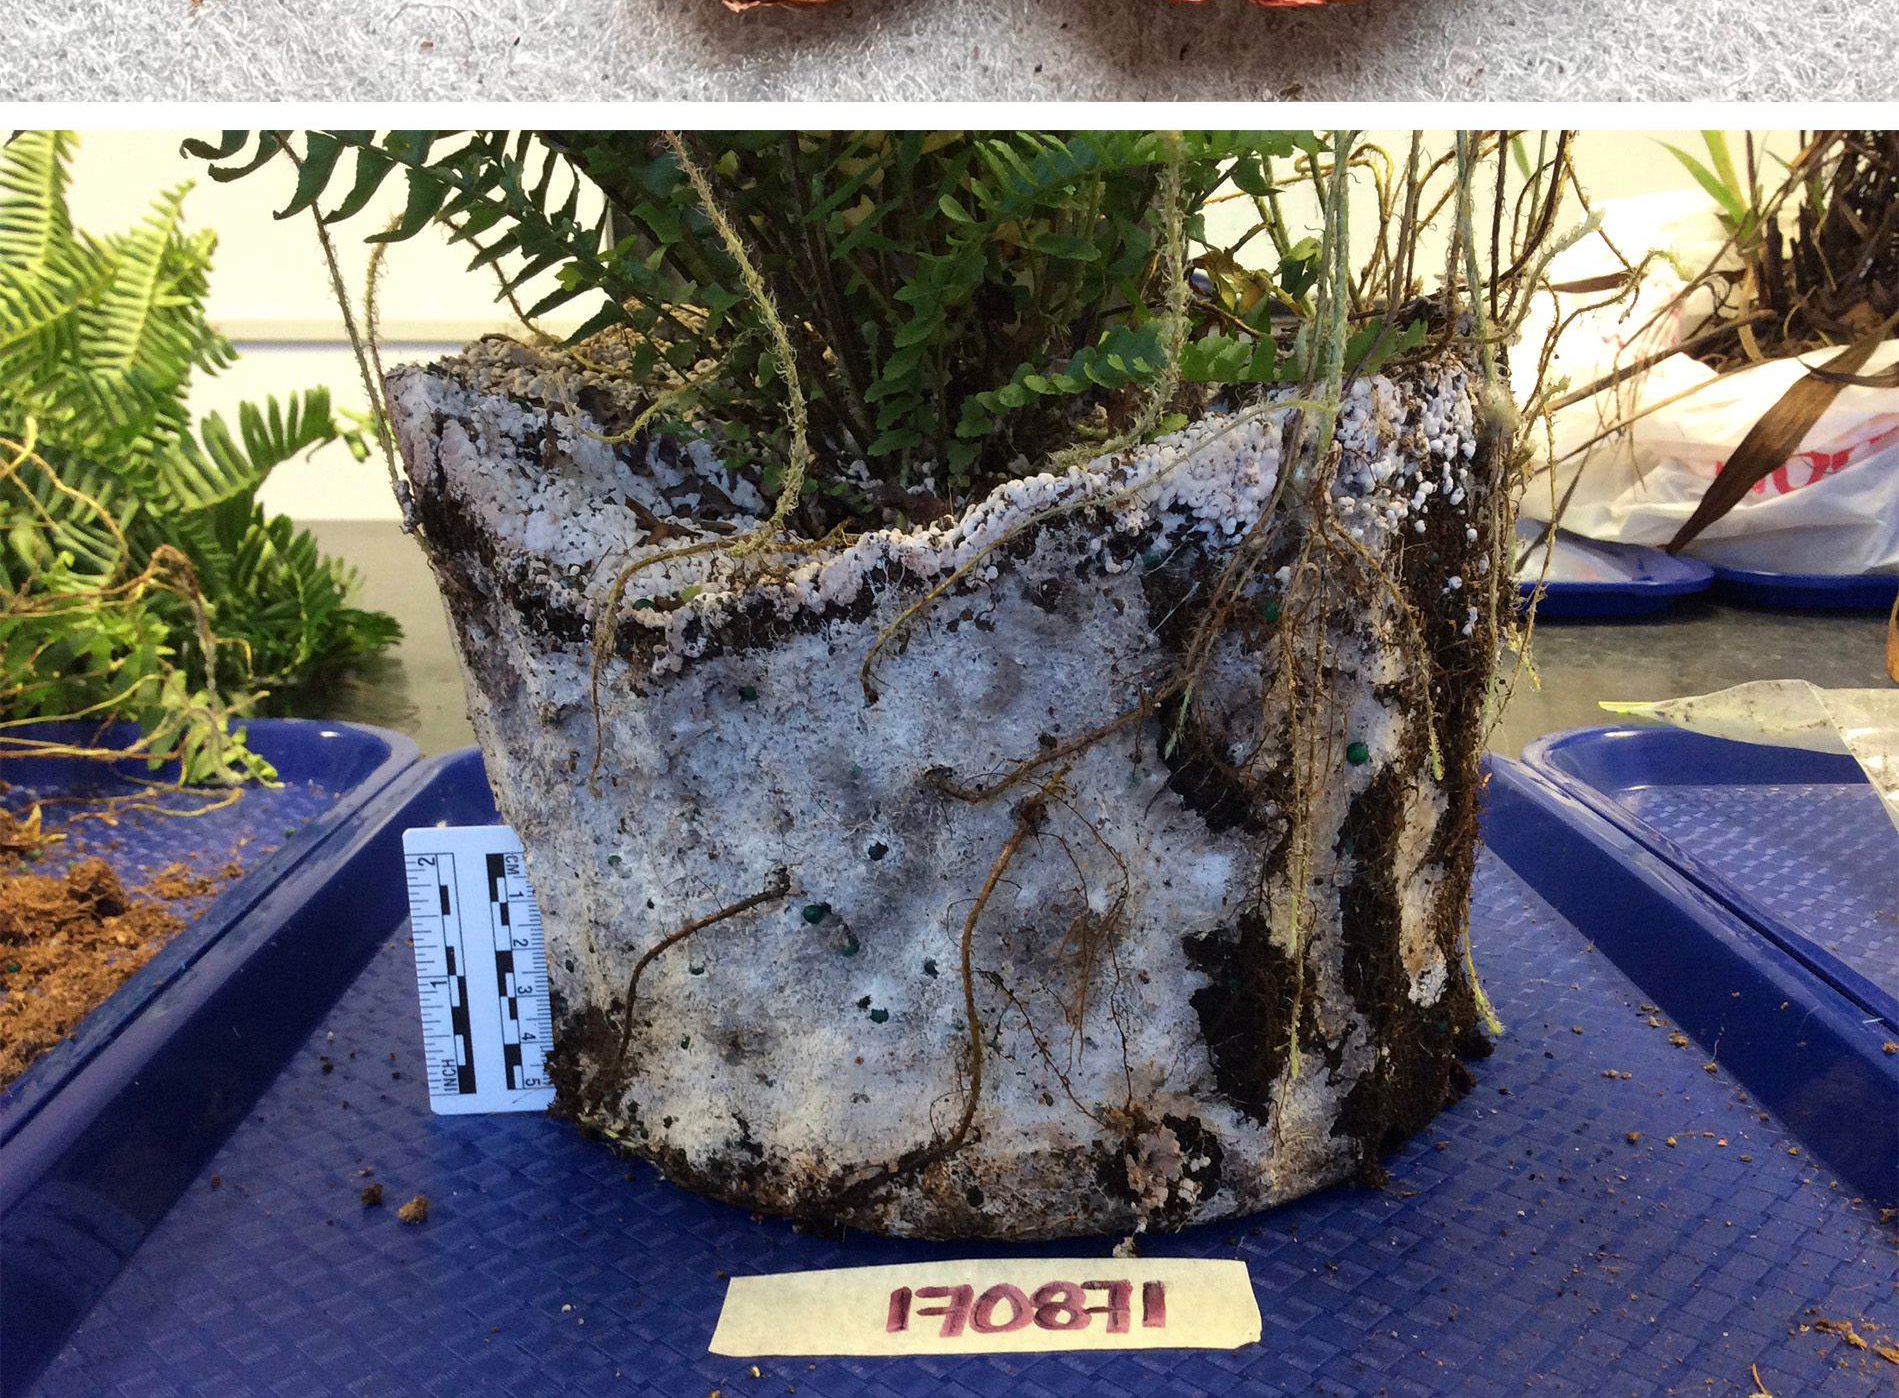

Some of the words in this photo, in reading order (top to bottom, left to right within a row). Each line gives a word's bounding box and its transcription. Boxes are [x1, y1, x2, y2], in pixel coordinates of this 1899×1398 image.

[418, 857, 435, 866] 2
[505, 856, 520, 875] CM
[513, 939, 528, 947] 2
[430, 980, 447, 989] 1
[518, 986, 533, 995] 3
[521, 1033, 536, 1041] 4
[441, 1059, 456, 1091] INCH
[526, 1078, 541, 1087] 5
[886, 1279, 1167, 1338] 170871
